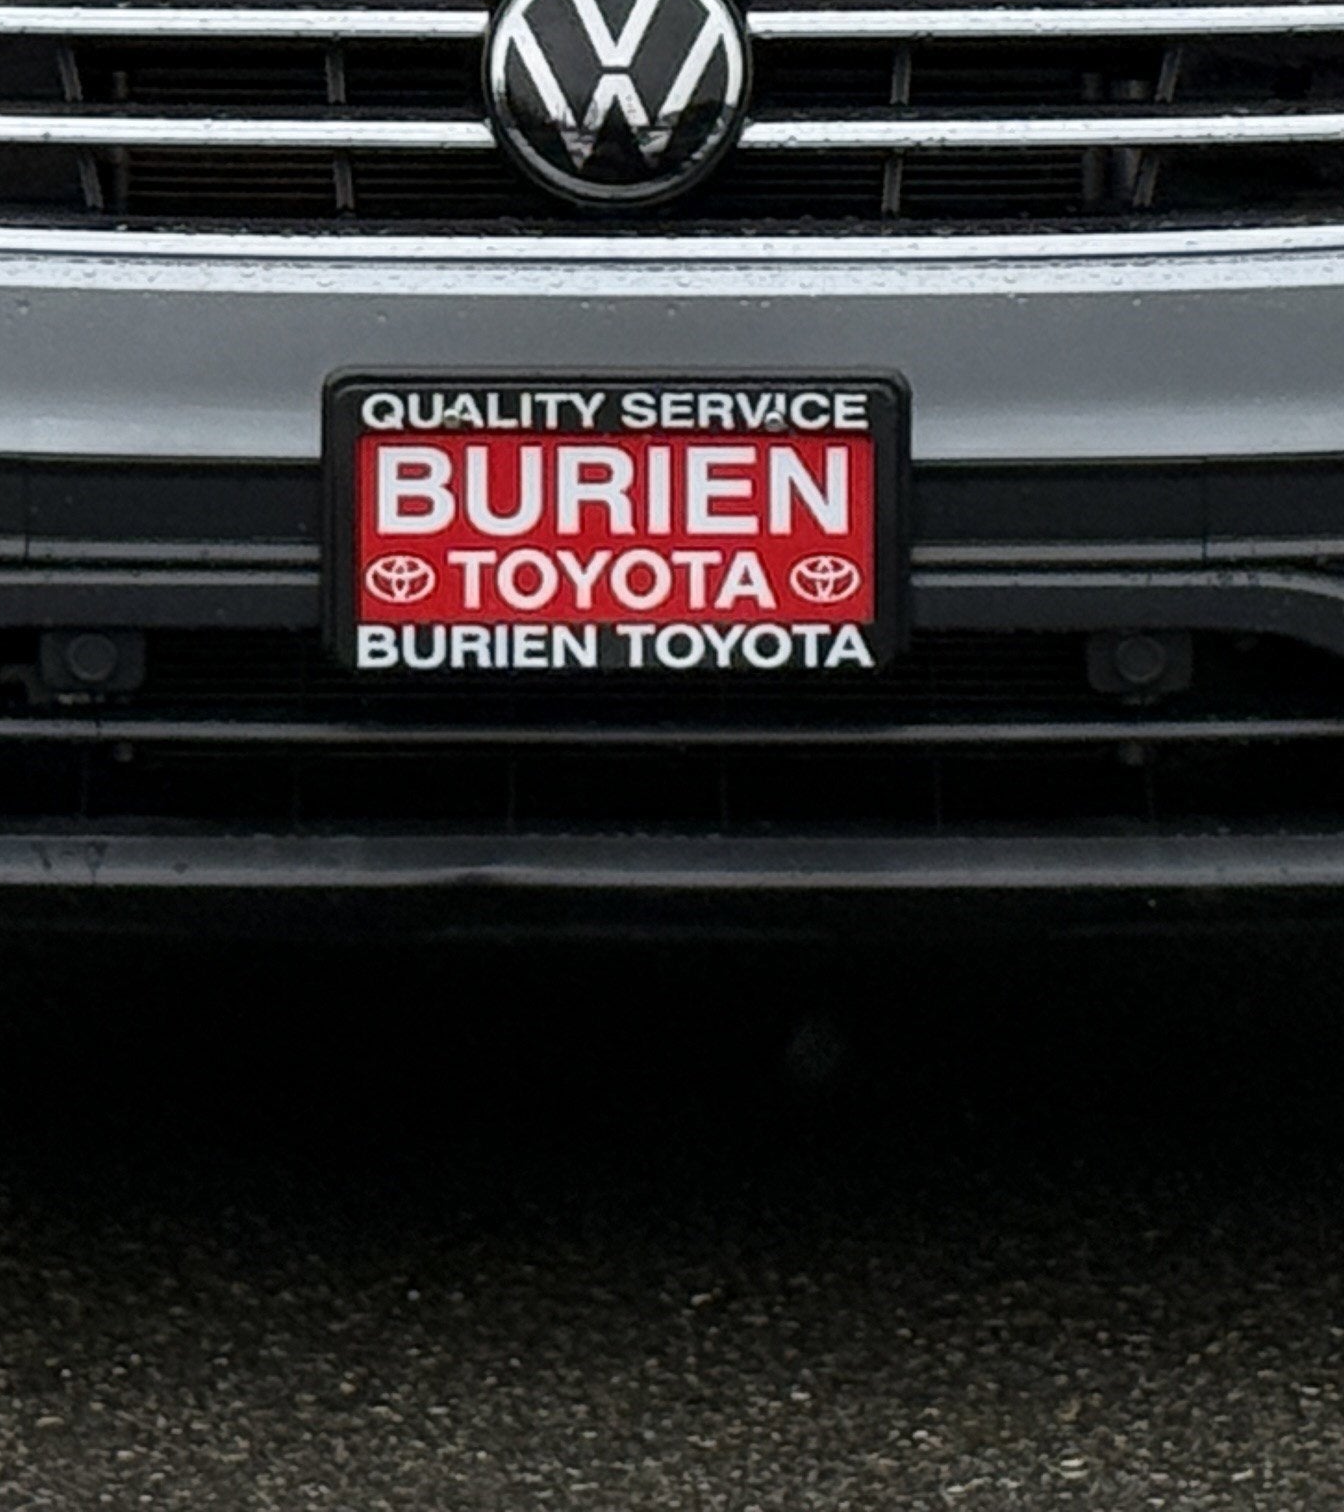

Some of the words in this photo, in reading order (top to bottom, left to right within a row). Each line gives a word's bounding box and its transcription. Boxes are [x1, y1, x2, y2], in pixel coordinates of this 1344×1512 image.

[361, 392, 606, 430] QUALITY
[620, 392, 869, 431] SERVICE
[376, 445, 850, 536] BURIEN
[447, 549, 778, 611] TOYOTA
[357, 624, 598, 670] BURIEN
[615, 624, 875, 670] TOYOTA
